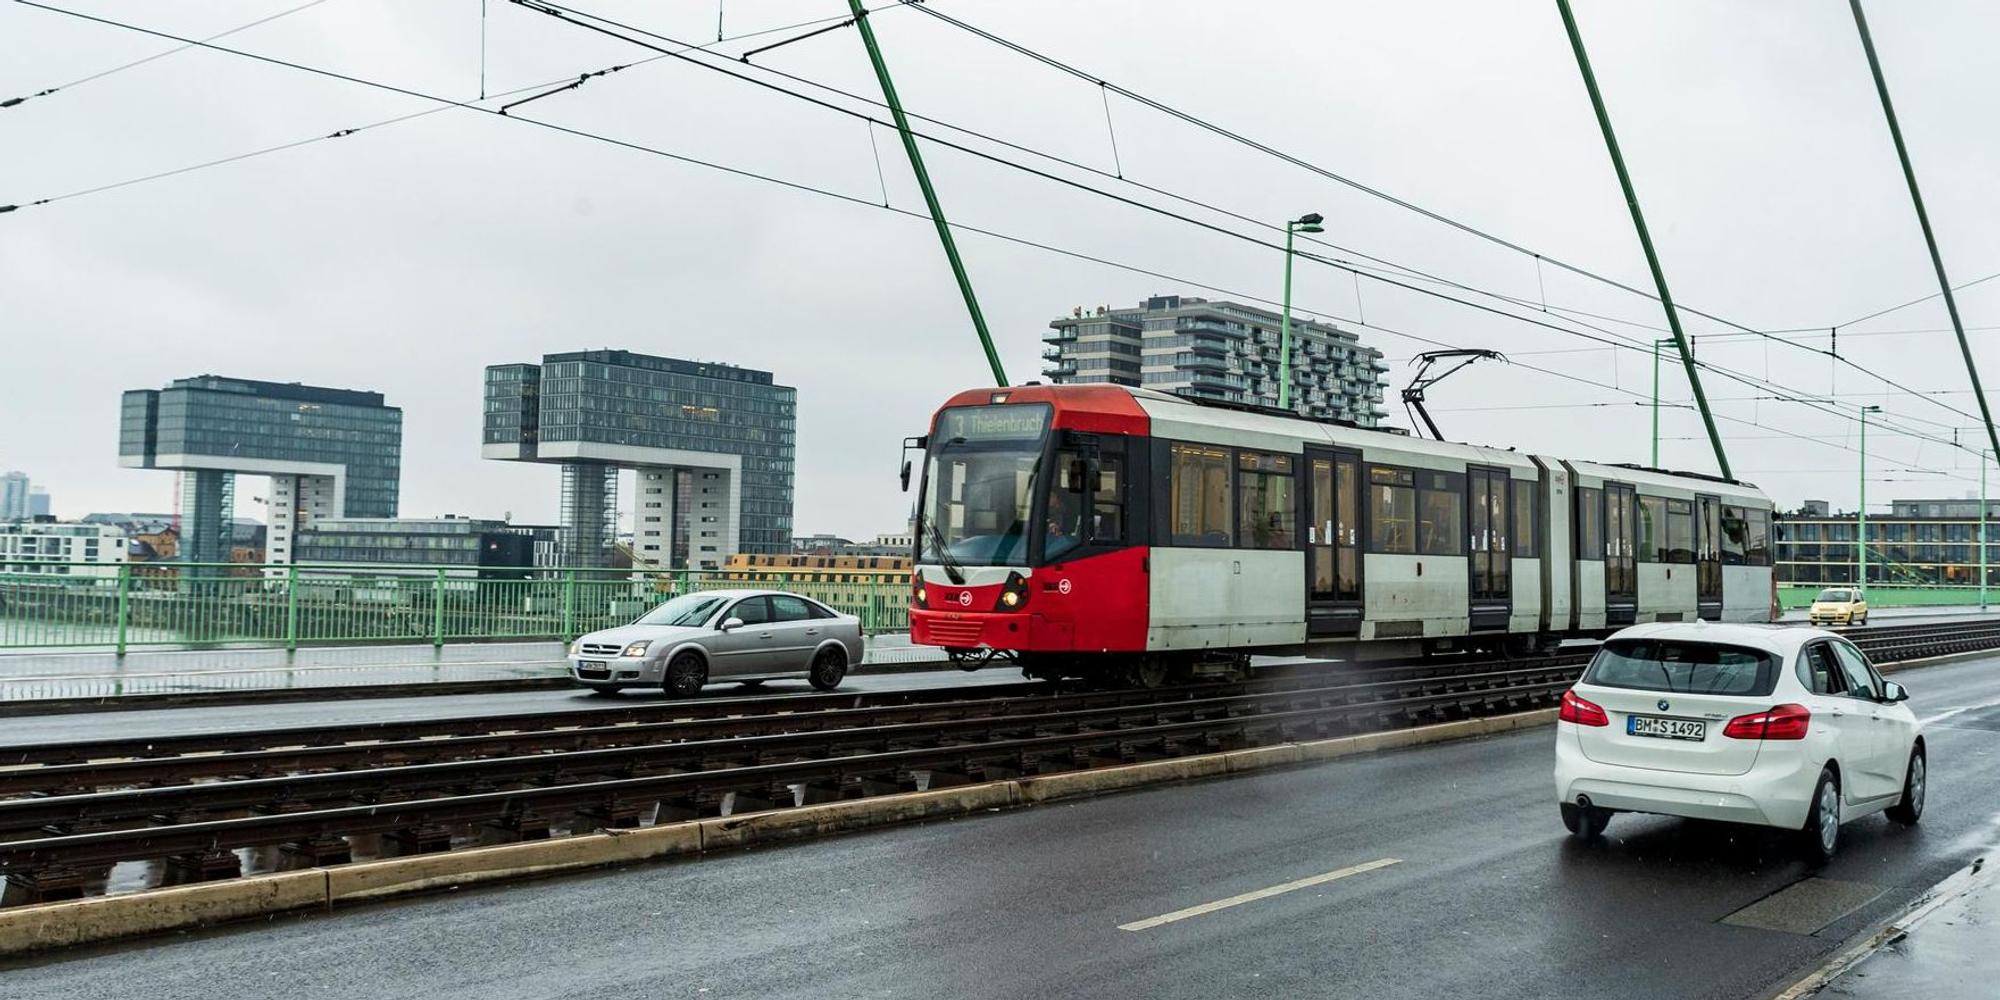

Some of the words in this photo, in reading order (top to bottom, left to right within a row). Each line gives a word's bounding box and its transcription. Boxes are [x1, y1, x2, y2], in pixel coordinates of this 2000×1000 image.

[954, 415, 964, 436] 3
[972, 412, 1042, 433] Thielenbruch
[1670, 721, 1702, 737] 1492
